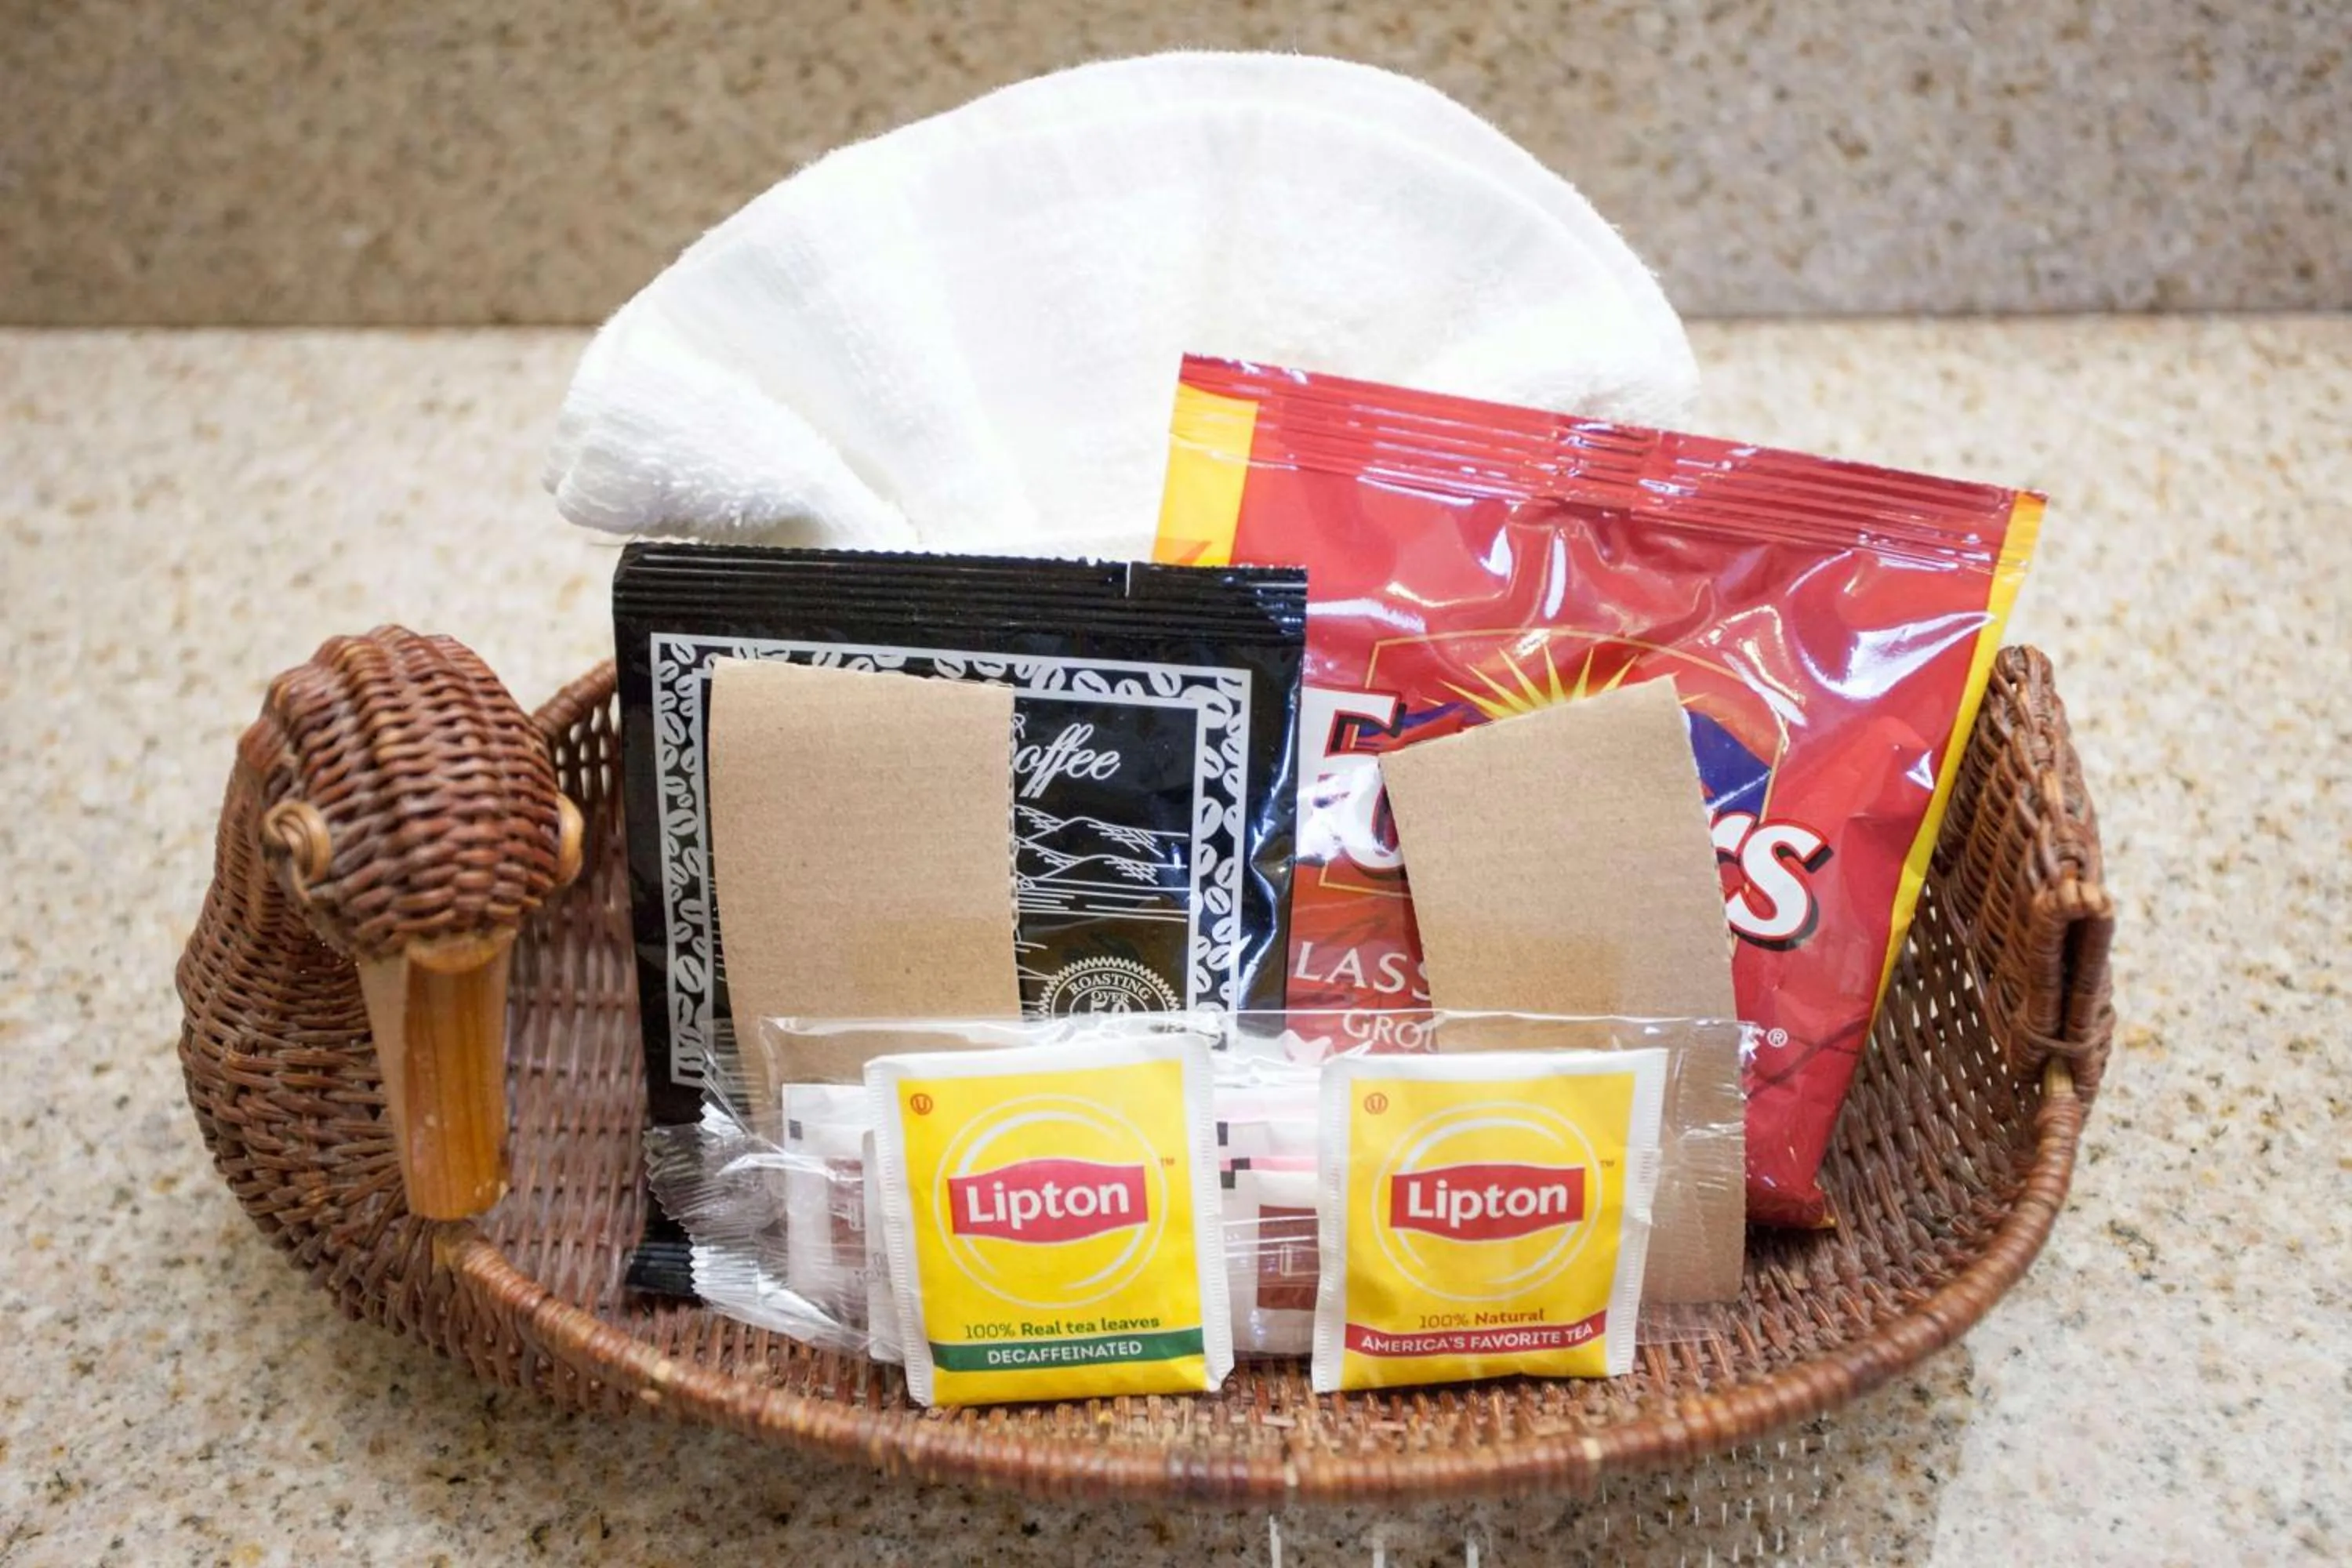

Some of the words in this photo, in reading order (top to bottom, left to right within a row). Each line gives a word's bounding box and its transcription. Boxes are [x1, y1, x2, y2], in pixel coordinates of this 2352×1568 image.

[1013, 723, 1121, 799] offee
[1067, 973, 1152, 1000] ROASTING
[1091, 991, 1130, 1004] OVER
[965, 1180, 1131, 1230] Lipton
[1408, 1178, 1567, 1229] Lipton
[965, 1324, 1015, 1339] 100%
[1021, 1320, 1062, 1337] Real
[1066, 1320, 1096, 1334] tea
[1101, 1317, 1160, 1331] leaves
[1419, 1312, 1469, 1329] 100%
[1475, 1308, 1544, 1324] Natural
[1361, 1335, 1465, 1352] AMERICA'S
[1470, 1330, 1562, 1349] FAVORITE
[1566, 1323, 1593, 1343] TEA
[987, 1341, 1143, 1365] DECAFFEINATED
